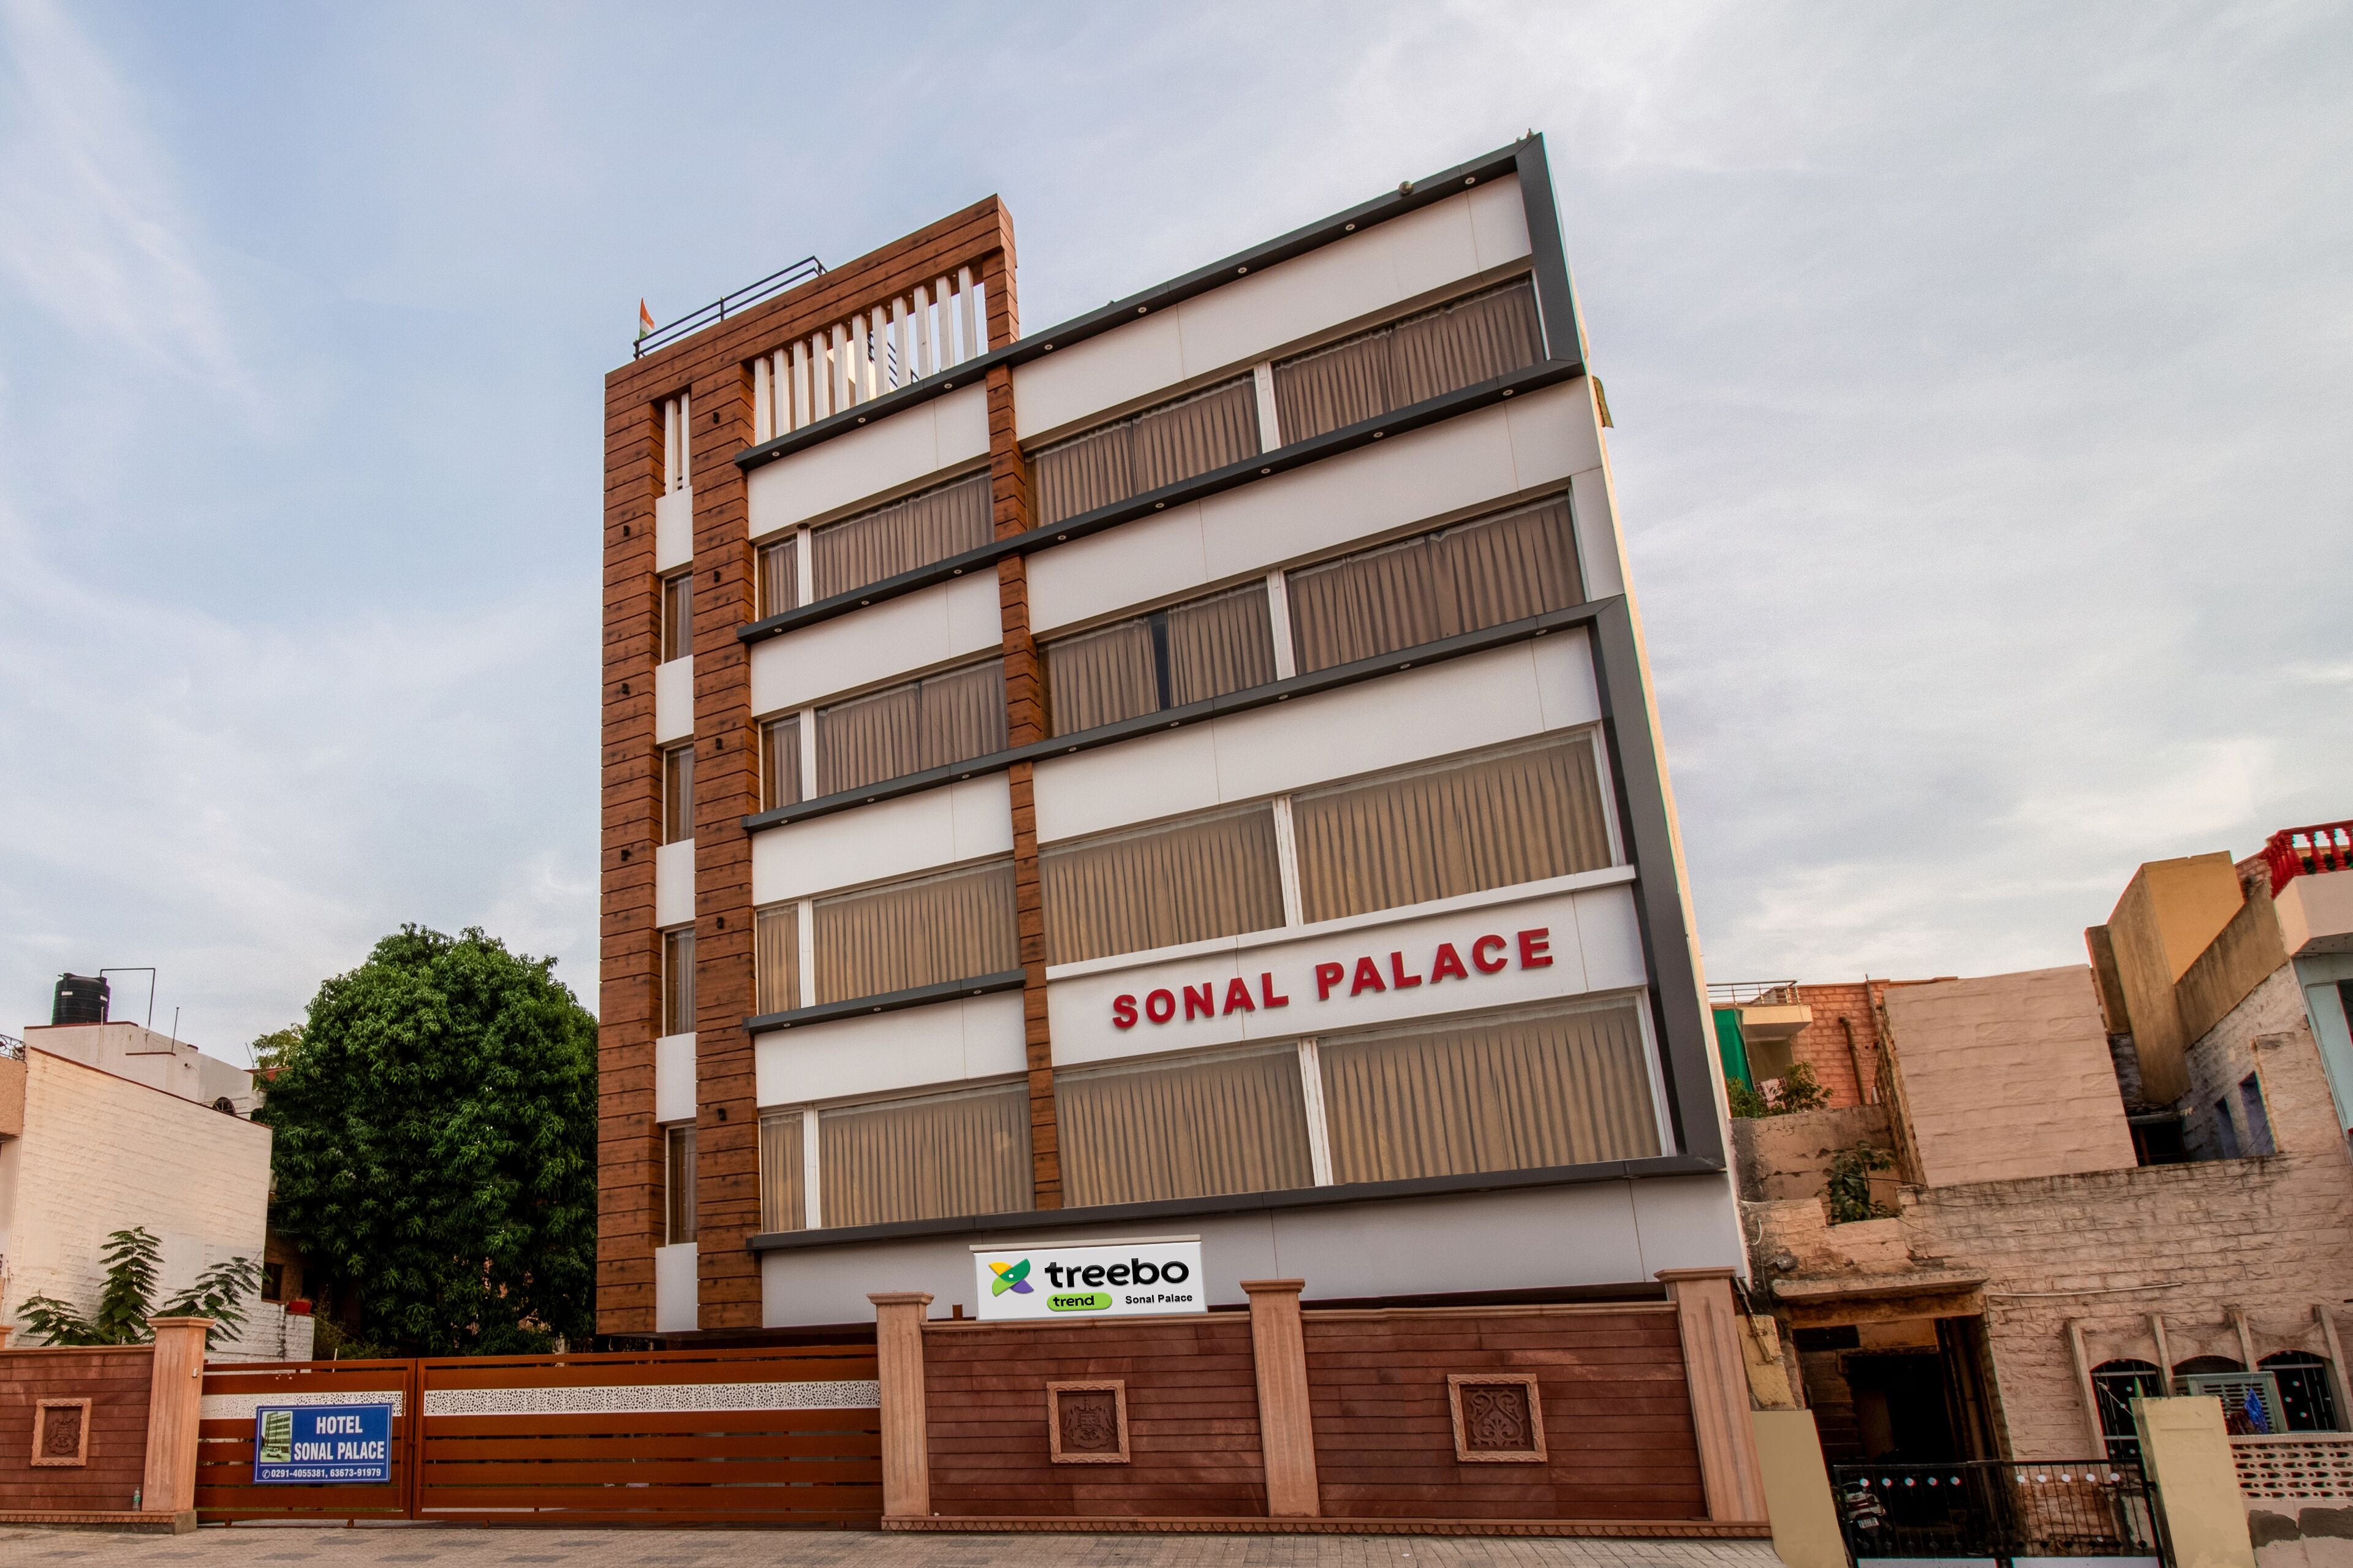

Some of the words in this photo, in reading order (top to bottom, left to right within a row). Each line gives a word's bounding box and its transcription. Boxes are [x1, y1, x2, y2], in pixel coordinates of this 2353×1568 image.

[1112, 971, 1289, 1029] SONAL
[1315, 927, 1554, 1001] PALACE
[1044, 1258, 1189, 1288] treebo
[1053, 1295, 1094, 1307] trend
[1125, 1294, 1154, 1304] Sonal
[1158, 1293, 1192, 1303] Palace
[316, 1415, 363, 1434] HOTEL
[294, 1442, 333, 1460] SONAL
[337, 1441, 385, 1460] PALACE
[271, 1469, 328, 1479] 0291-4055381,
[330, 1468, 381, 1477] 63673-91979
